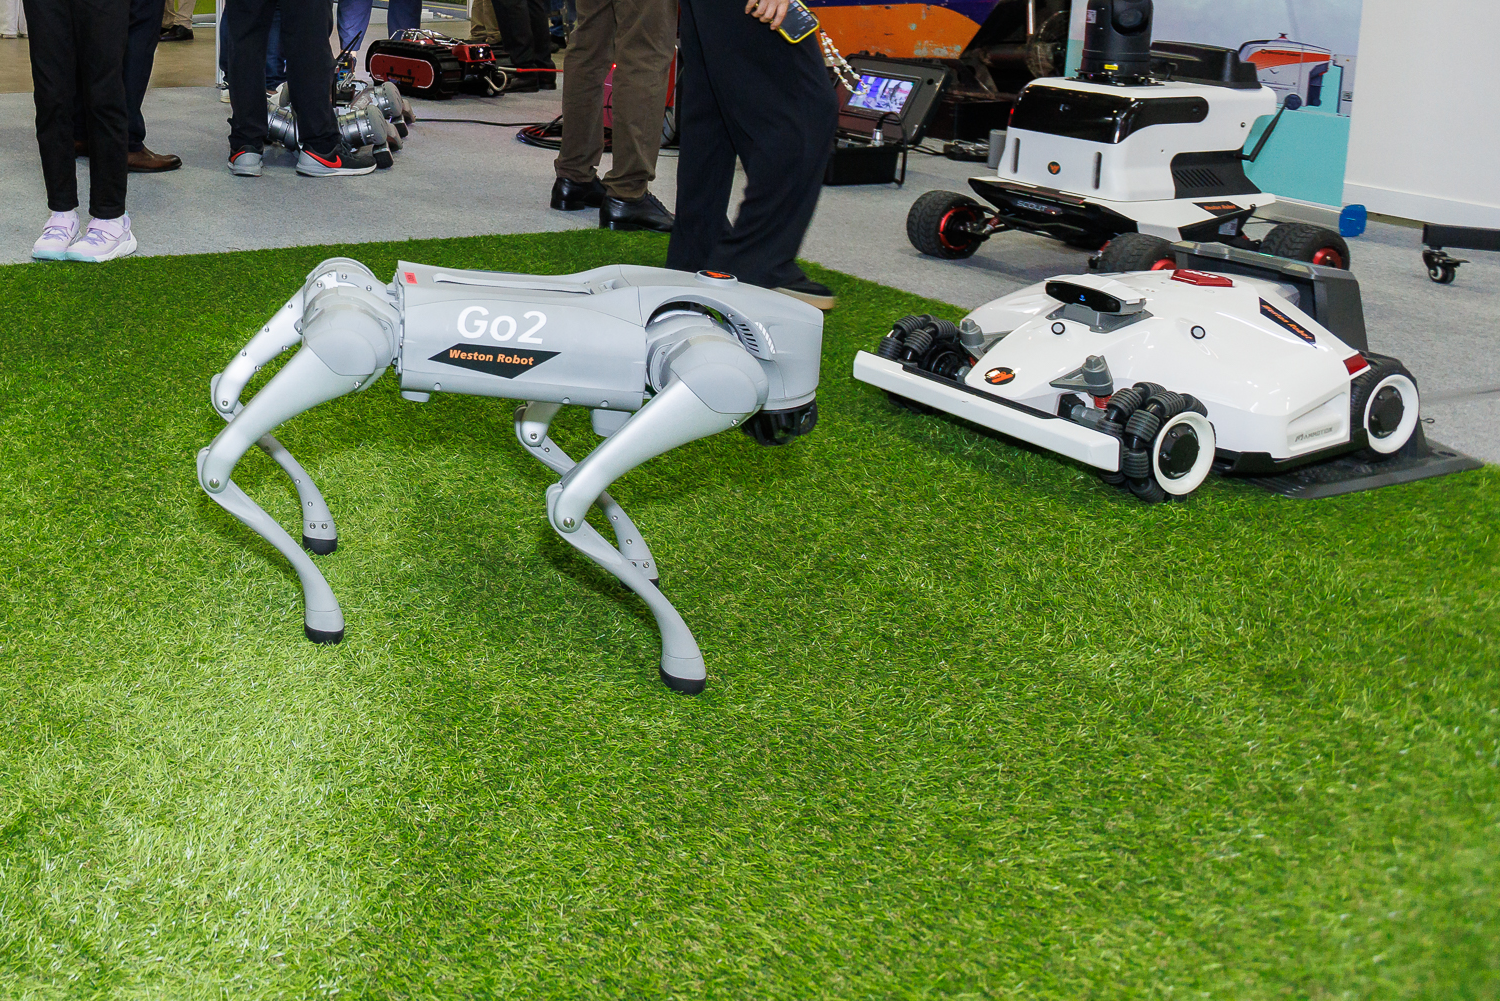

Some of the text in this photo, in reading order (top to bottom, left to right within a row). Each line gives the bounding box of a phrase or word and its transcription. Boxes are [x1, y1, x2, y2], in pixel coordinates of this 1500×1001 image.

[1017, 200, 1047, 211] SCOUT
[457, 305, 547, 345] Go2
[449, 349, 535, 365] Weston Robot
